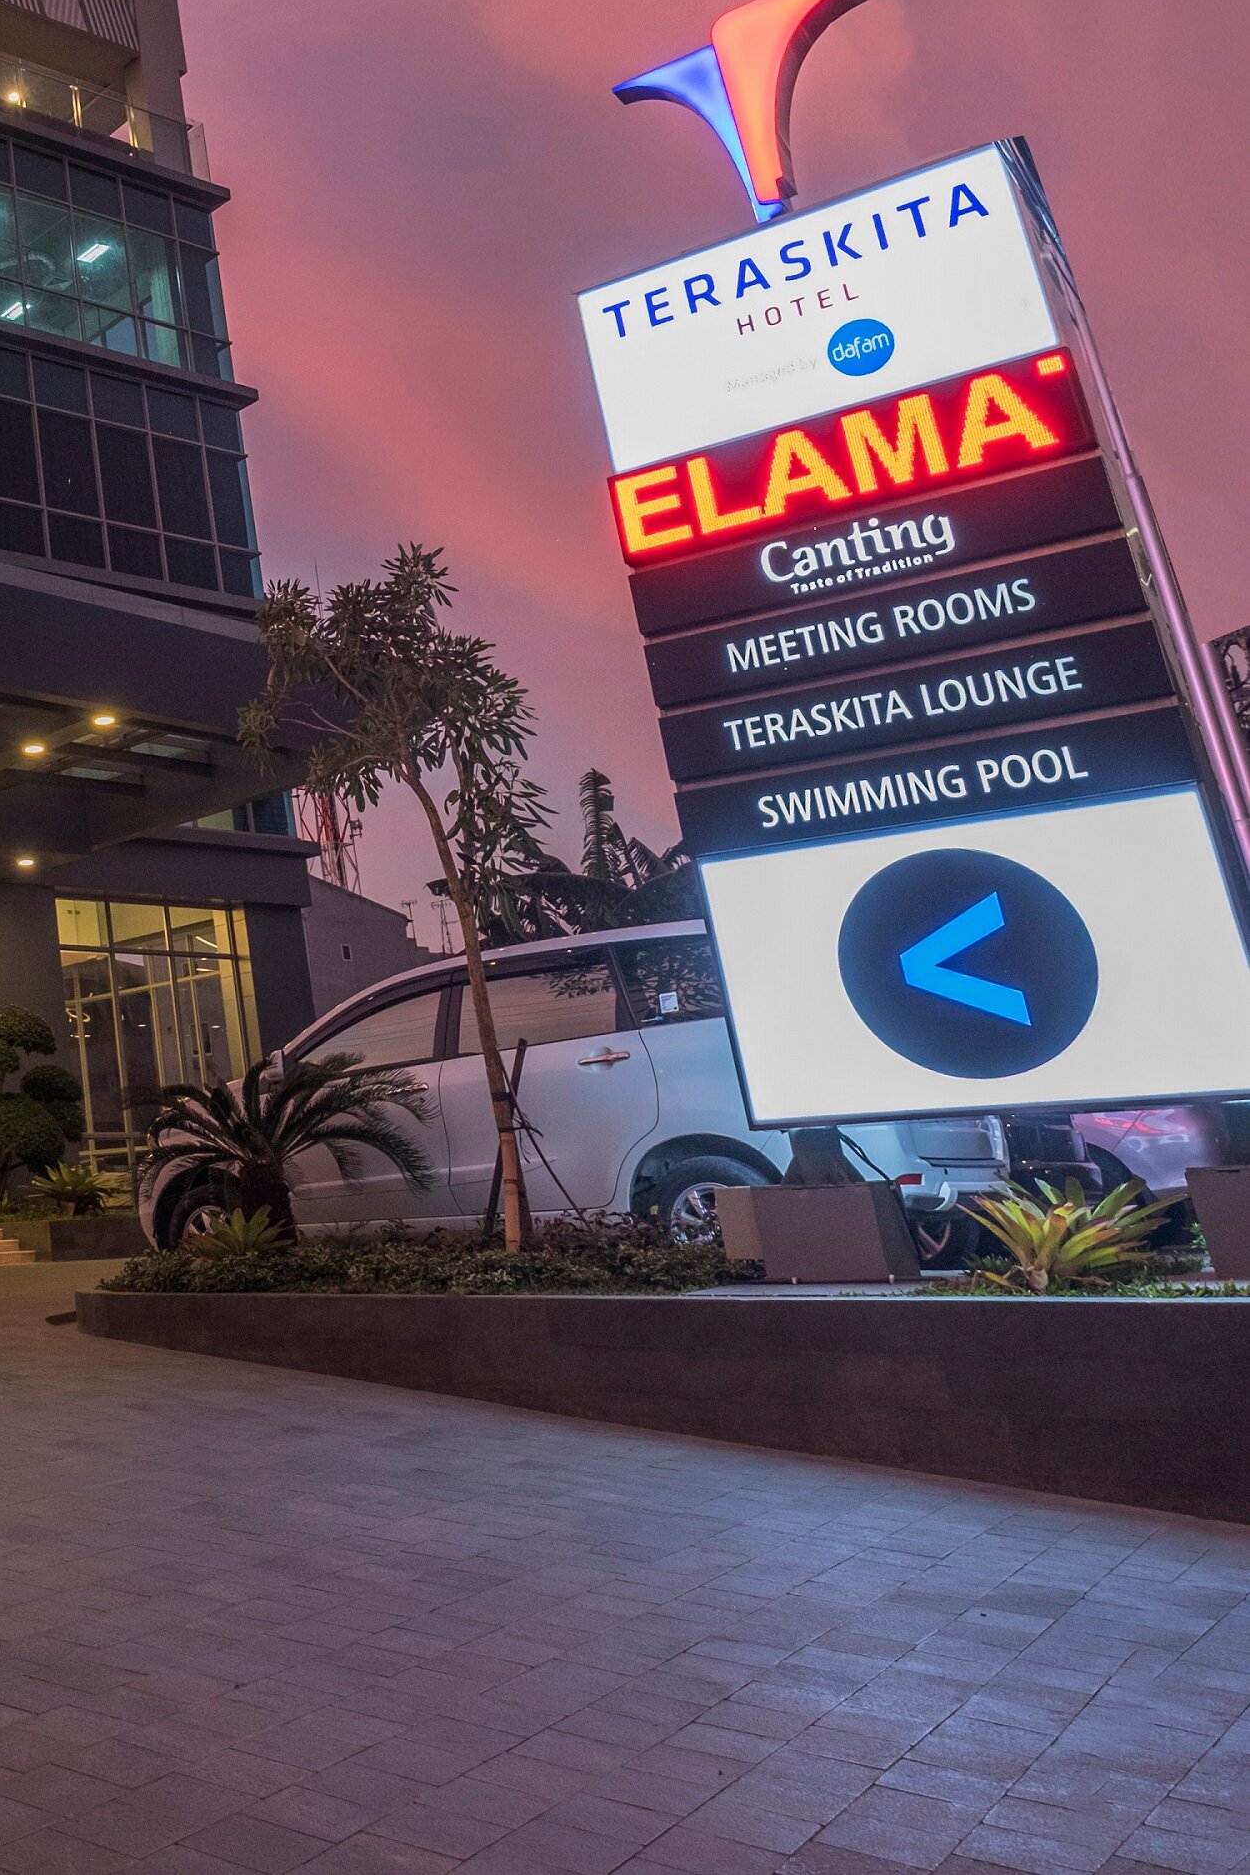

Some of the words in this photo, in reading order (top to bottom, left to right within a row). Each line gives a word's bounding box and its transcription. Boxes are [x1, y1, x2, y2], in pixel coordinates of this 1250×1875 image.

[602, 183, 990, 338] TERASKITA
[736, 283, 860, 336] HOTEL
[832, 331, 890, 362] dafam
[614, 355, 1064, 553] ELAMA
[761, 514, 956, 583] Canting
[790, 577, 834, 595] Taste
[836, 570, 853, 584] of
[854, 552, 934, 580] Tradition
[726, 611, 885, 673] MEETING
[893, 578, 1036, 638] ROOMS
[723, 689, 913, 751] TERASKITA
[919, 656, 1083, 717] LOUNGE
[757, 764, 968, 828] SWIMMING
[976, 745, 1089, 793] POOL
